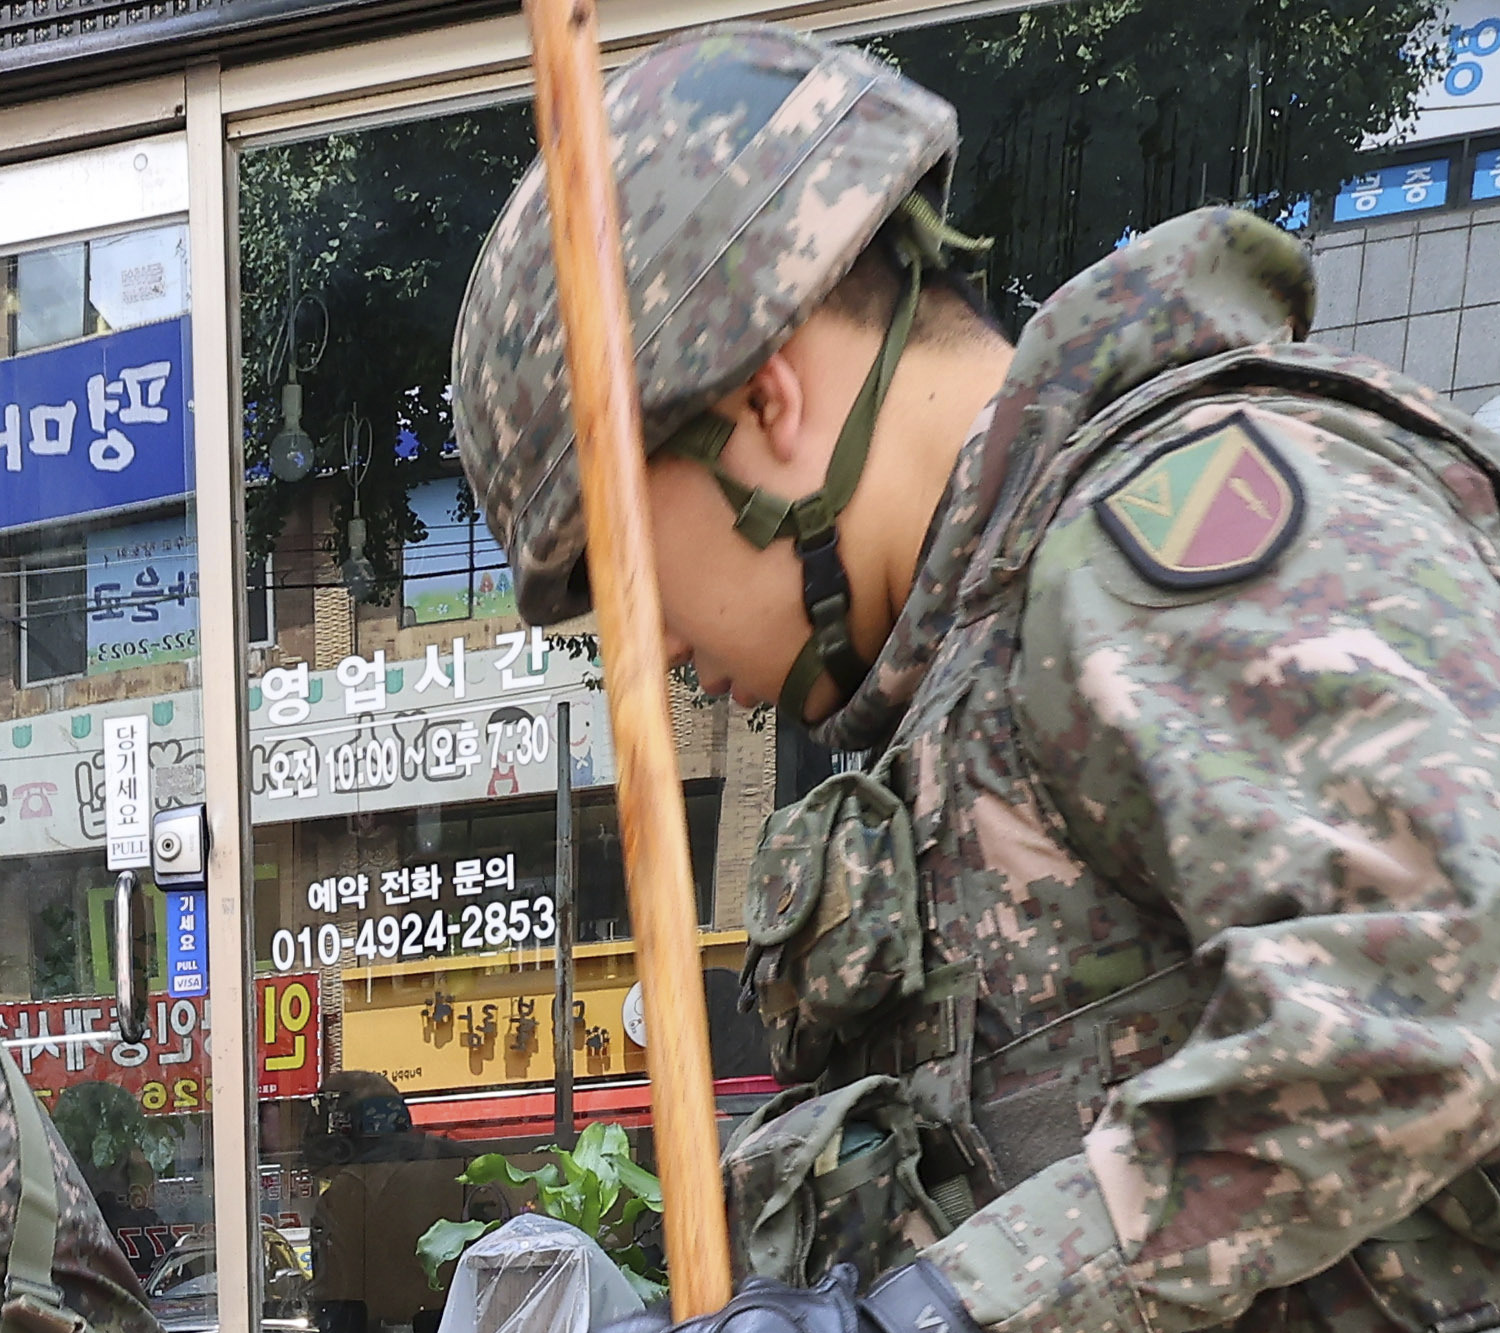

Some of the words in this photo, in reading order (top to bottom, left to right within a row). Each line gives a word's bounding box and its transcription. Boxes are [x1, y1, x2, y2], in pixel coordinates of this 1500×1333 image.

[262, 627, 552, 727] 영업시간
[114, 723, 139, 826] 당기세요
[268, 752, 318, 801] 오전
[326, 739, 399, 792] 10:00
[430, 726, 482, 778] 오후
[488, 716, 549, 769] 7:30
[110, 838, 149, 856] PULL
[307, 868, 369, 915] 예약
[380, 861, 442, 908] 전화
[451, 852, 516, 898] 문의
[176, 960, 199, 972] PULL
[271, 896, 556, 972] 010-4924-2853
[176, 977, 201, 989] VISA
